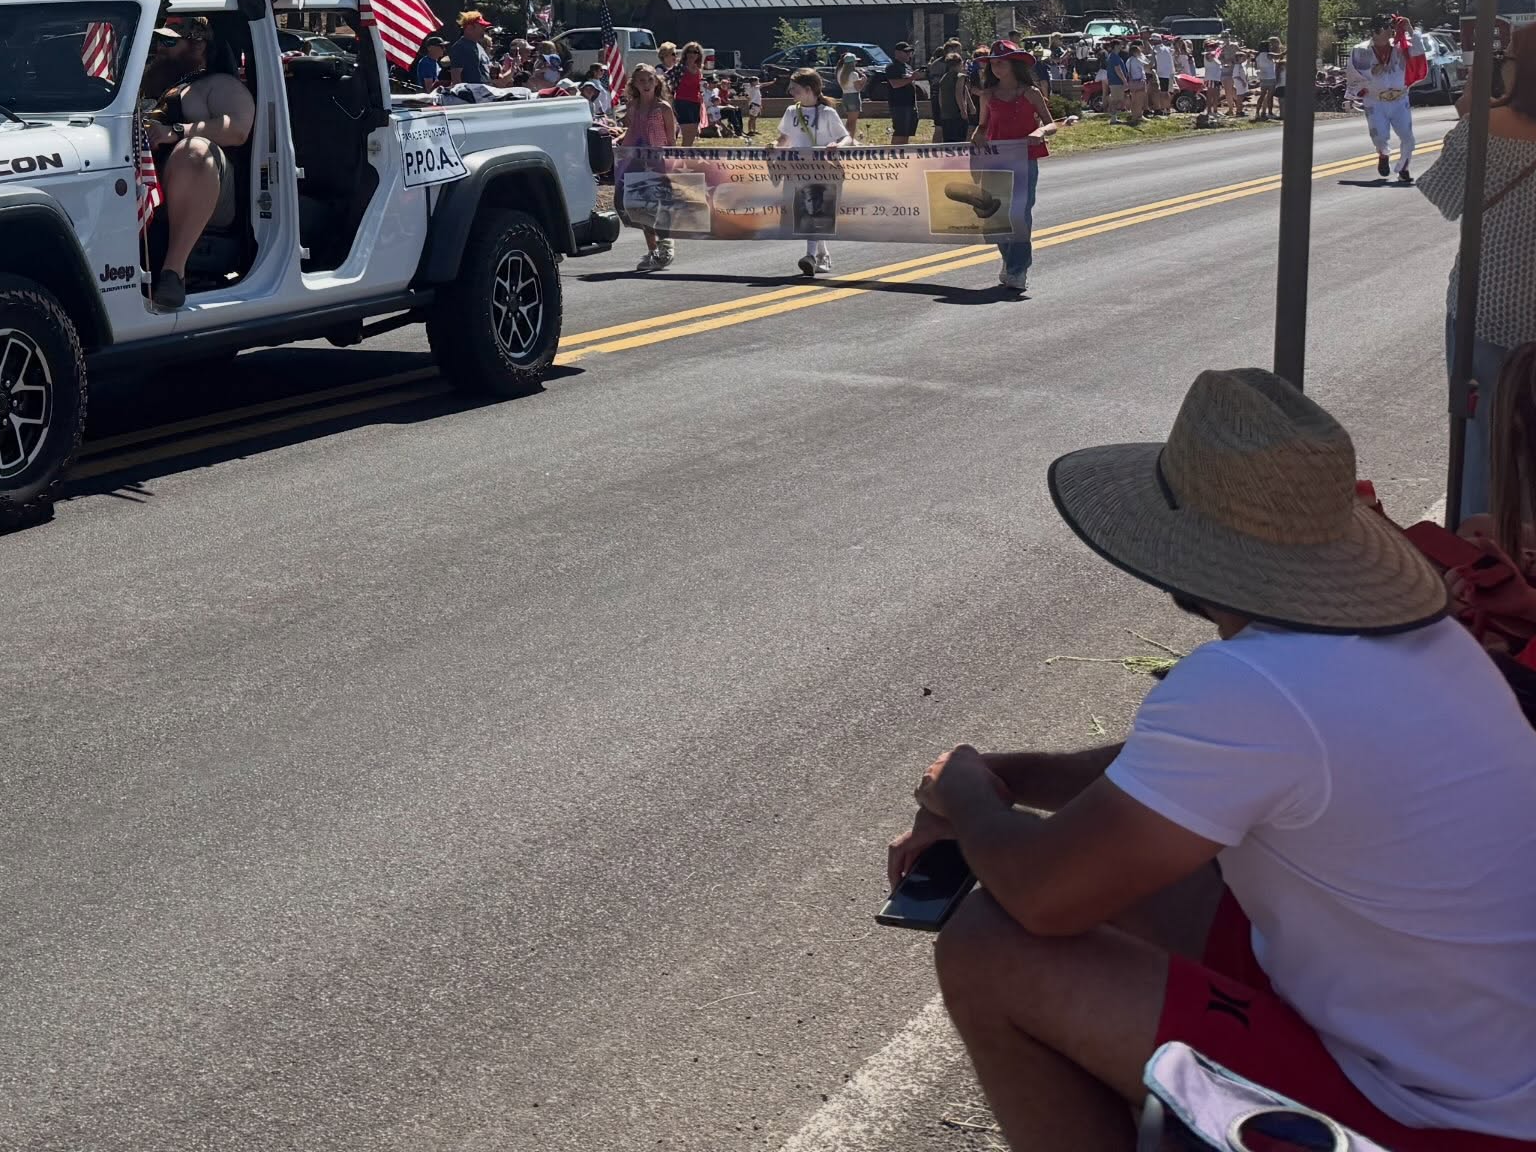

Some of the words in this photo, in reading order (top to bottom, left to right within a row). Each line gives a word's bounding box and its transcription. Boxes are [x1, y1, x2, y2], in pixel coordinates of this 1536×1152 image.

[402, 131, 423, 141] PARADE
[423, 127, 447, 139] SPONSOR
[664, 148, 720, 160] FRANK
[726, 149, 771, 161] LUKE
[777, 150, 805, 161] JR.
[813, 149, 910, 161] MEMORIAL
[917, 144, 1000, 159] MUSEUM
[405, 147, 459, 176] P.P.O.A.
[829, 161, 909, 170] ANNIVERSARY
[730, 173, 745, 183] OF
[797, 173, 811, 182] TO
[814, 173, 840, 181] OUR
[843, 172, 900, 181] COUNTRY
[892, 206, 920, 217] 2018
[99, 263, 135, 283] Jeep
